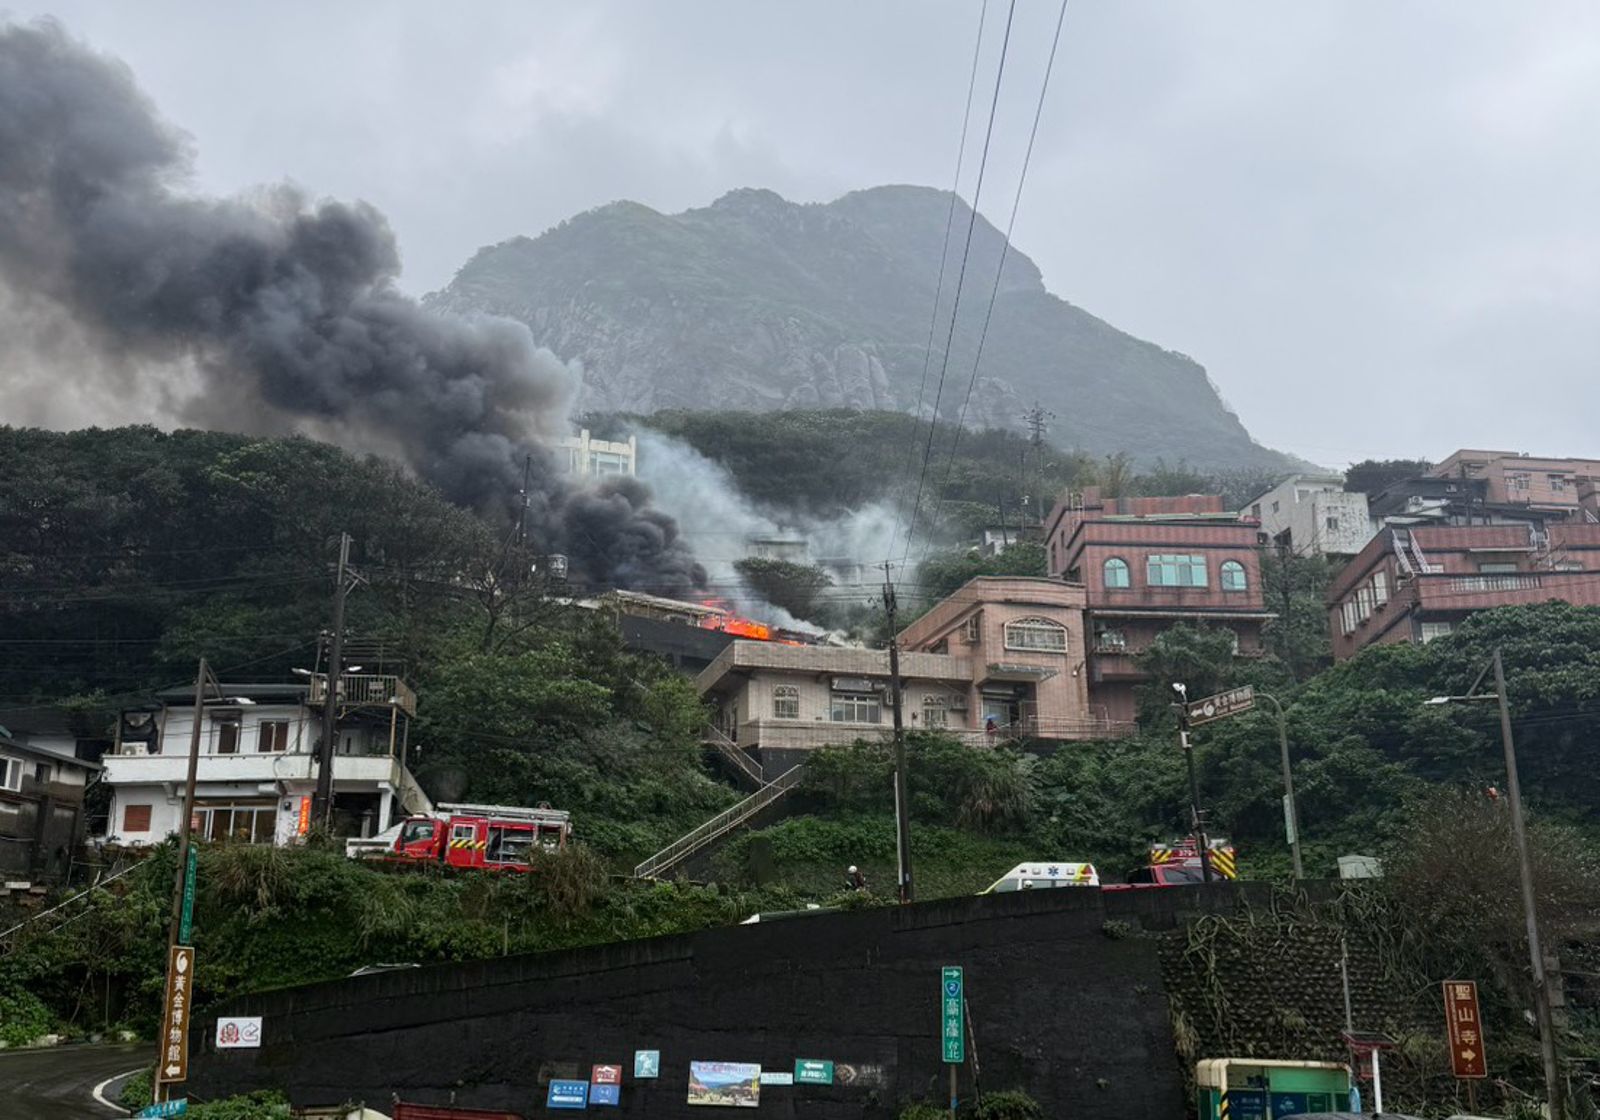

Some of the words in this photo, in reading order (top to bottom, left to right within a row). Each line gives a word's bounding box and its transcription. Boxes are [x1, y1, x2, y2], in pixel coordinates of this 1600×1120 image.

[949, 983, 956, 992] 2
[946, 998, 959, 1016] 宜蘭
[1455, 984, 1477, 1046] 聖山寺
[167, 975, 186, 1061] 黃金博物館
[946, 1019, 959, 1037] 基隆
[946, 1041, 960, 1059] 台北
